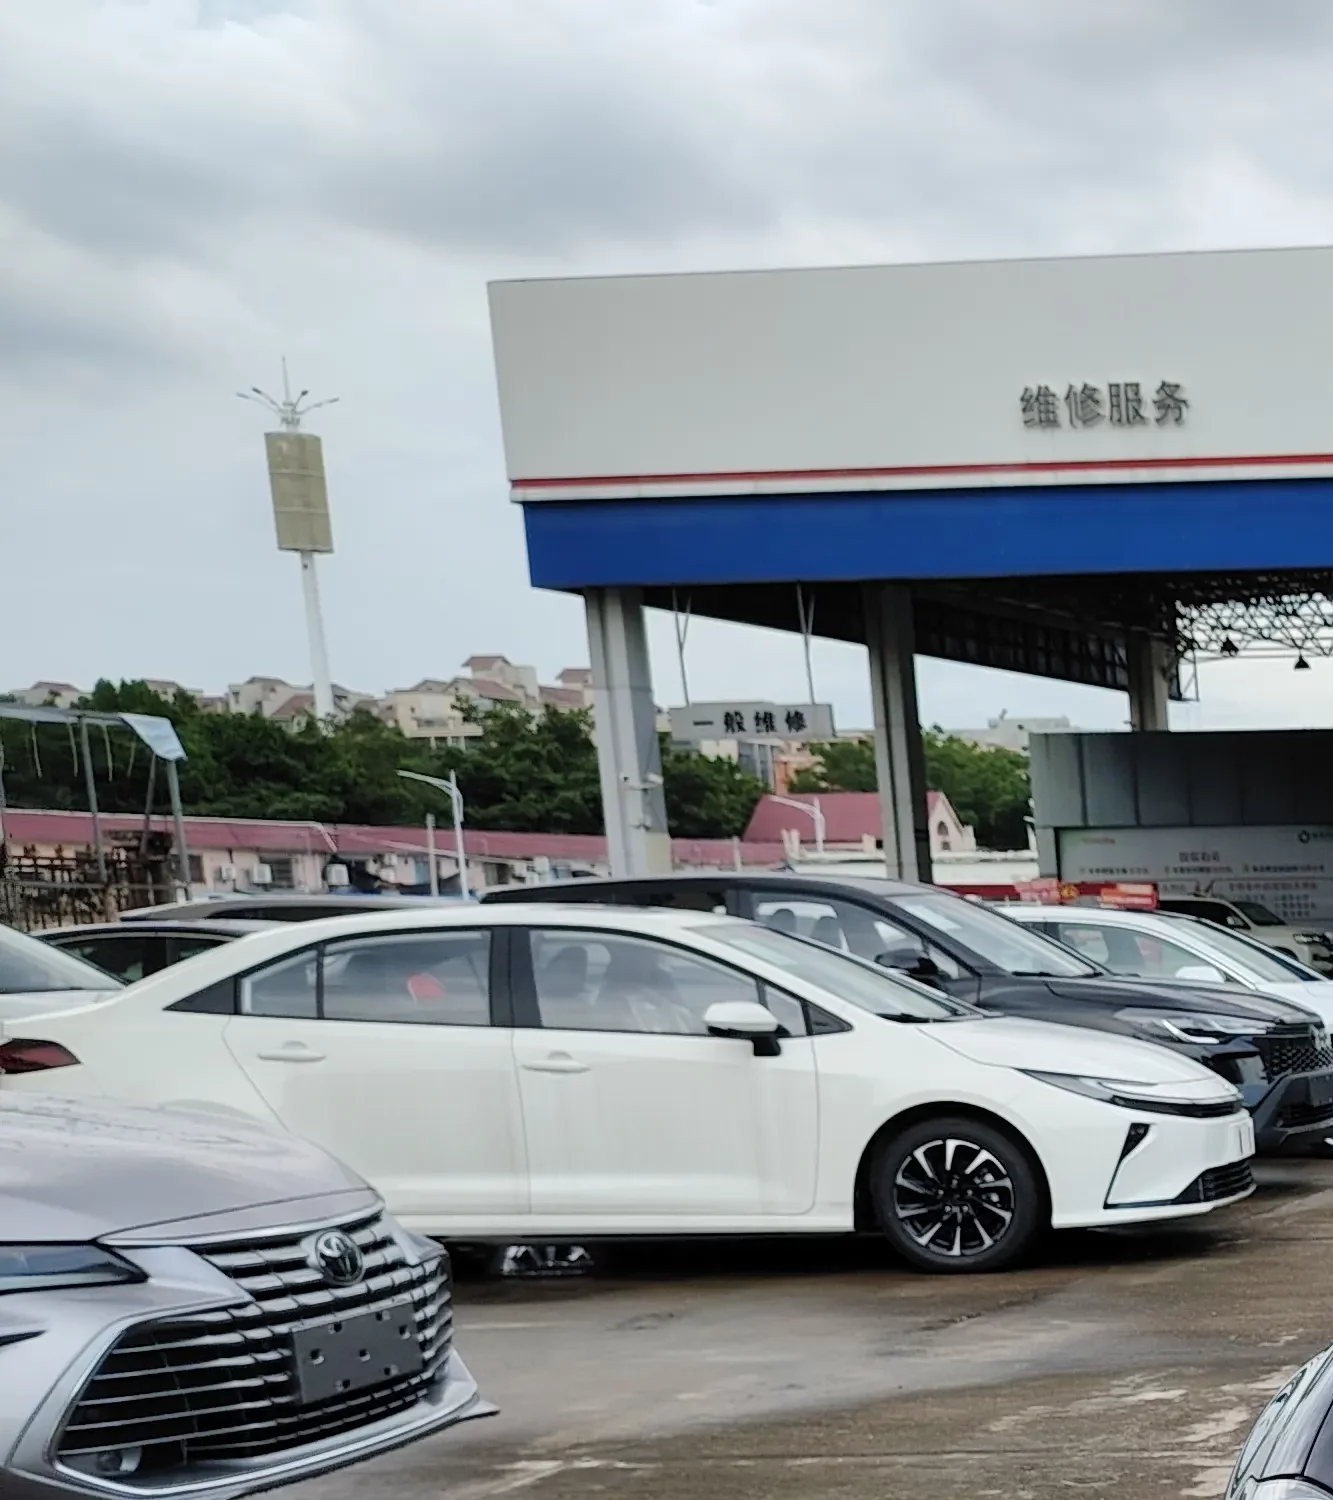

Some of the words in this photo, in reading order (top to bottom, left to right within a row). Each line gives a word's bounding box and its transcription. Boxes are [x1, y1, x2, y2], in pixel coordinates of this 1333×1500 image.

[1020, 380, 1191, 430] 维修服务
[693, 710, 808, 734] 一般维修
